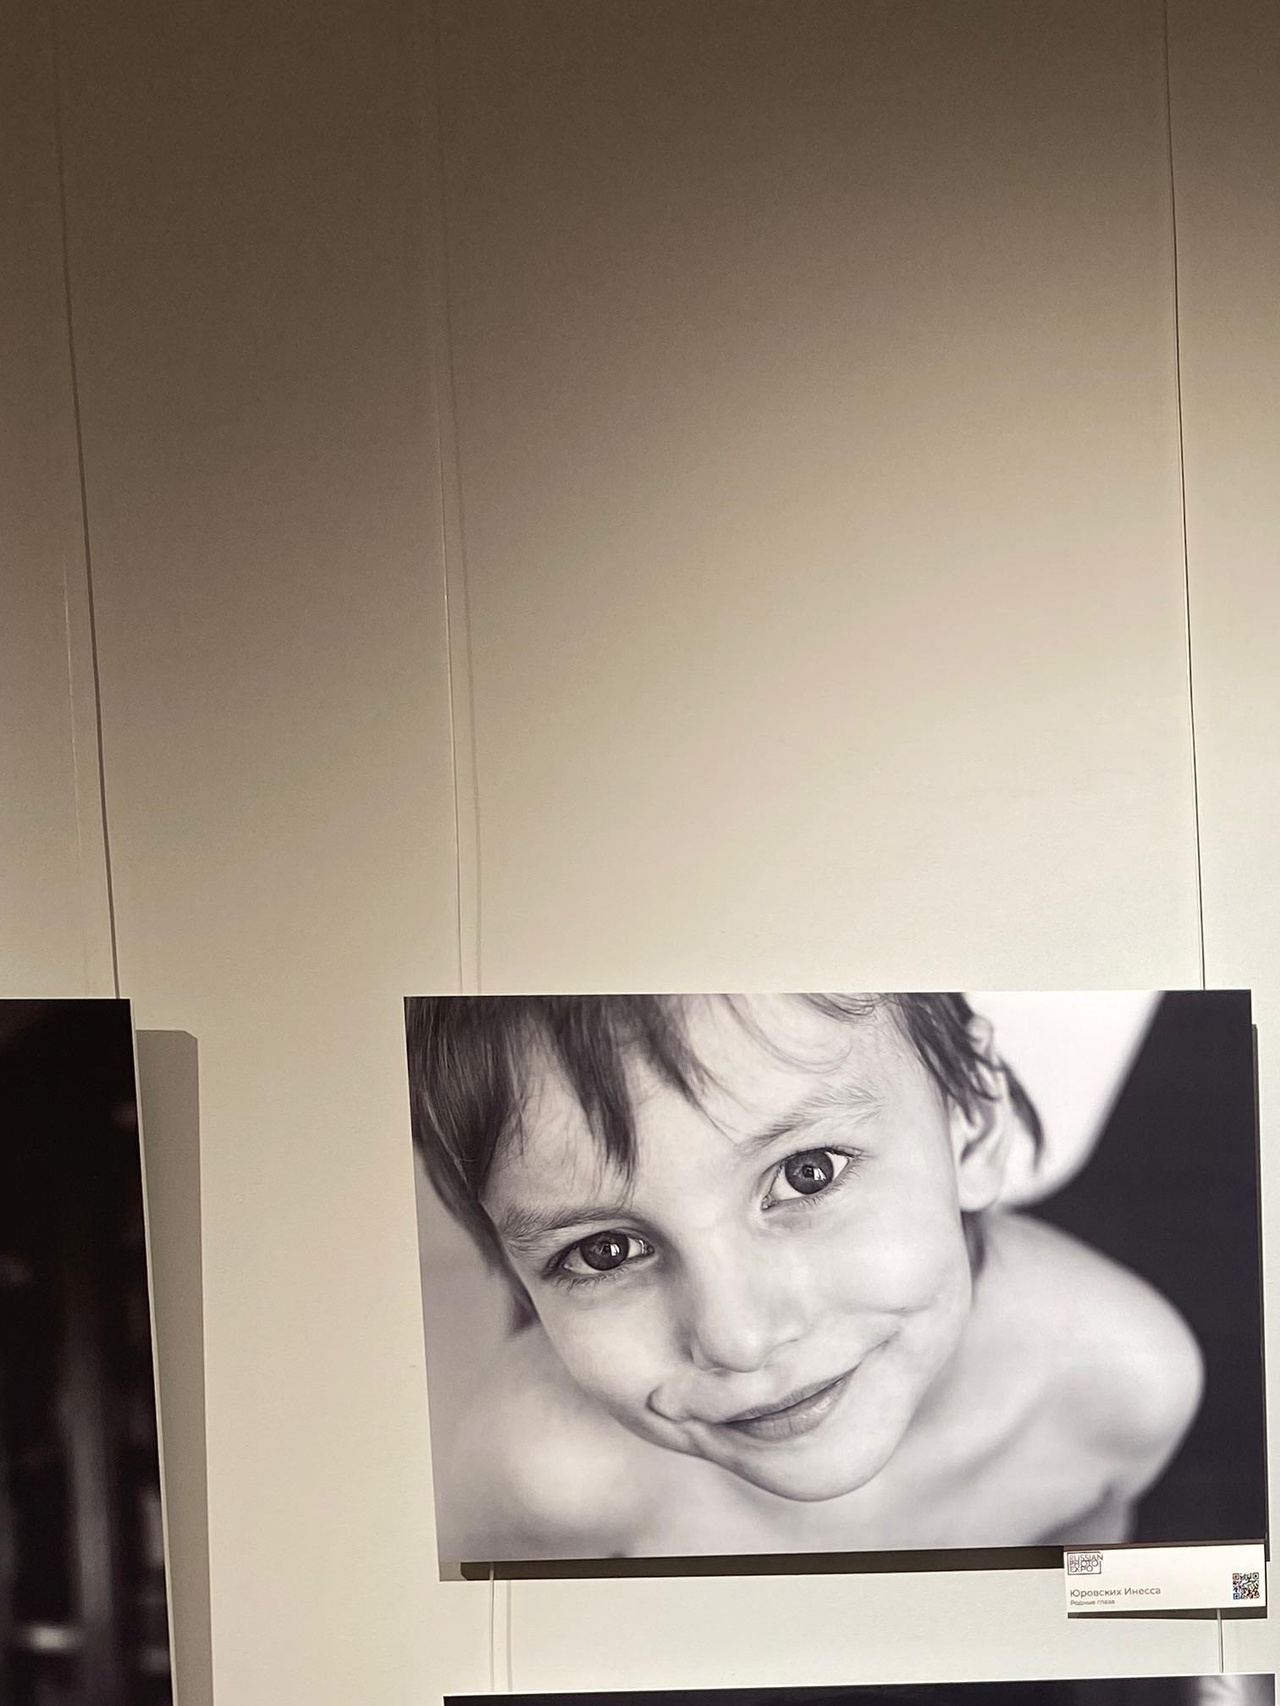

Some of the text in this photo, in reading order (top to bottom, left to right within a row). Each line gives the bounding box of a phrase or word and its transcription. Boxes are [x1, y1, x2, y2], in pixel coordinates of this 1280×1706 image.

[1070, 1553, 1104, 1562] RUSSIAN
[1070, 1587, 1161, 1598] Юровских Инесса
